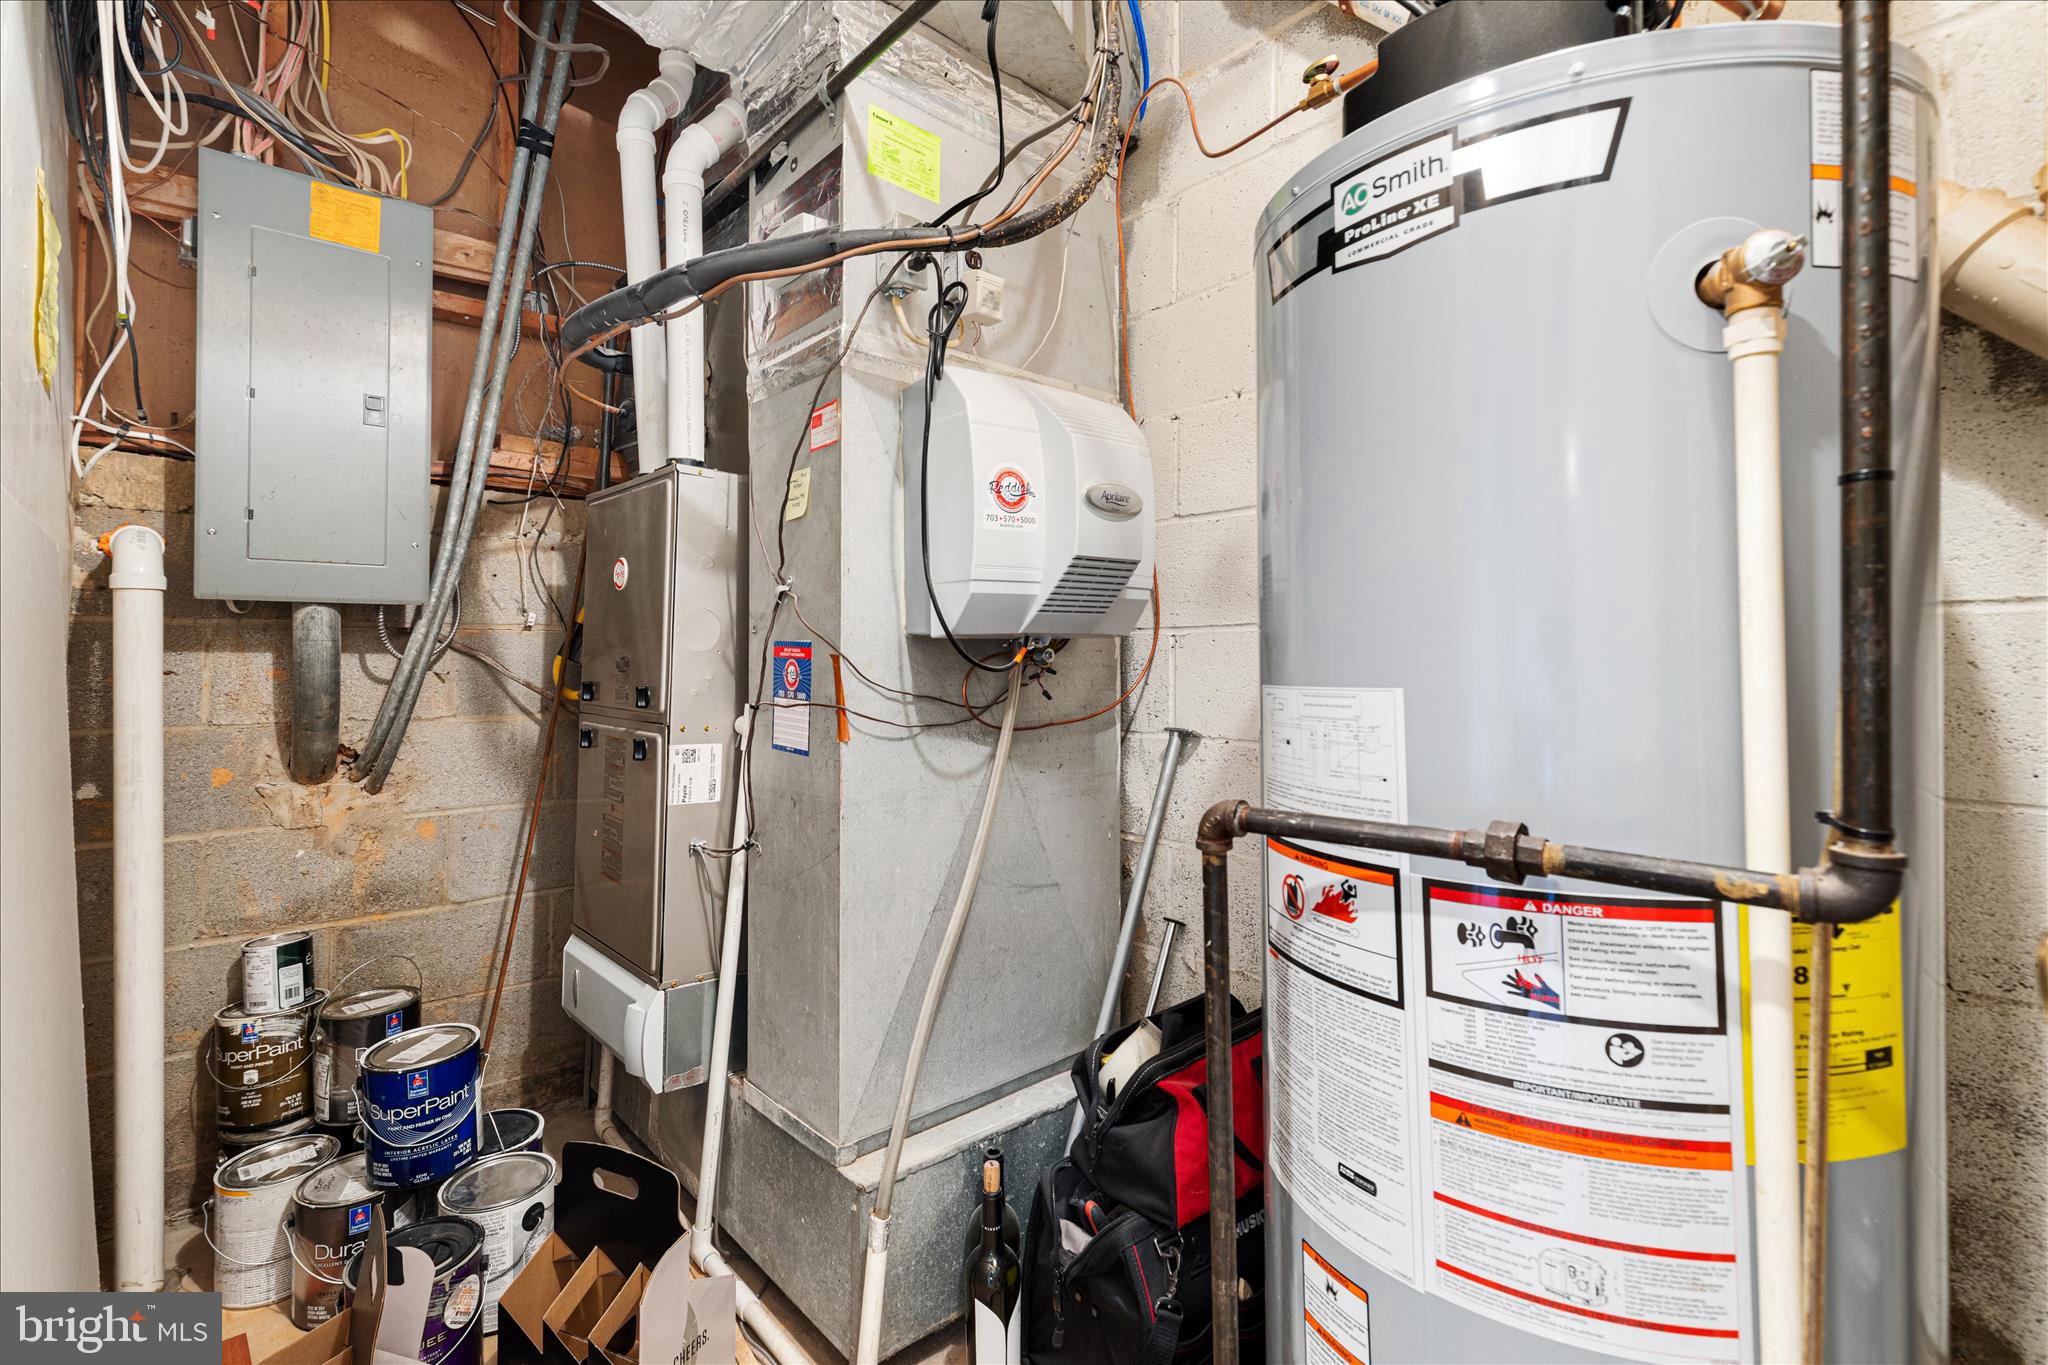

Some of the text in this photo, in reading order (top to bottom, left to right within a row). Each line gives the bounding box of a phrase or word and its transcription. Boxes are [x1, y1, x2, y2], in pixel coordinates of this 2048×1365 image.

[1341, 156, 1444, 216] AO Smith
[1344, 193, 1440, 243] ProLine XE
[1347, 220, 1434, 258] COMMERCIAL GRADE
[1542, 903, 1603, 917] DANGER
[370, 1083, 470, 1124] SuperPaint
[1513, 1081, 1641, 1108] IMPORTANT/IMPORTANTE
[415, 1119, 435, 1128] PRIMER
[384, 1148, 411, 1156] INTERIOR
[413, 1141, 440, 1153] ACRYLIC
[441, 1133, 459, 1144] LATEX
[413, 1175, 431, 1184] GLOSS
[1235, 1209, 1266, 1238] HUSK
[315, 1239, 369, 1261] Dura
[673, 1328, 710, 1365] CHEERS.
